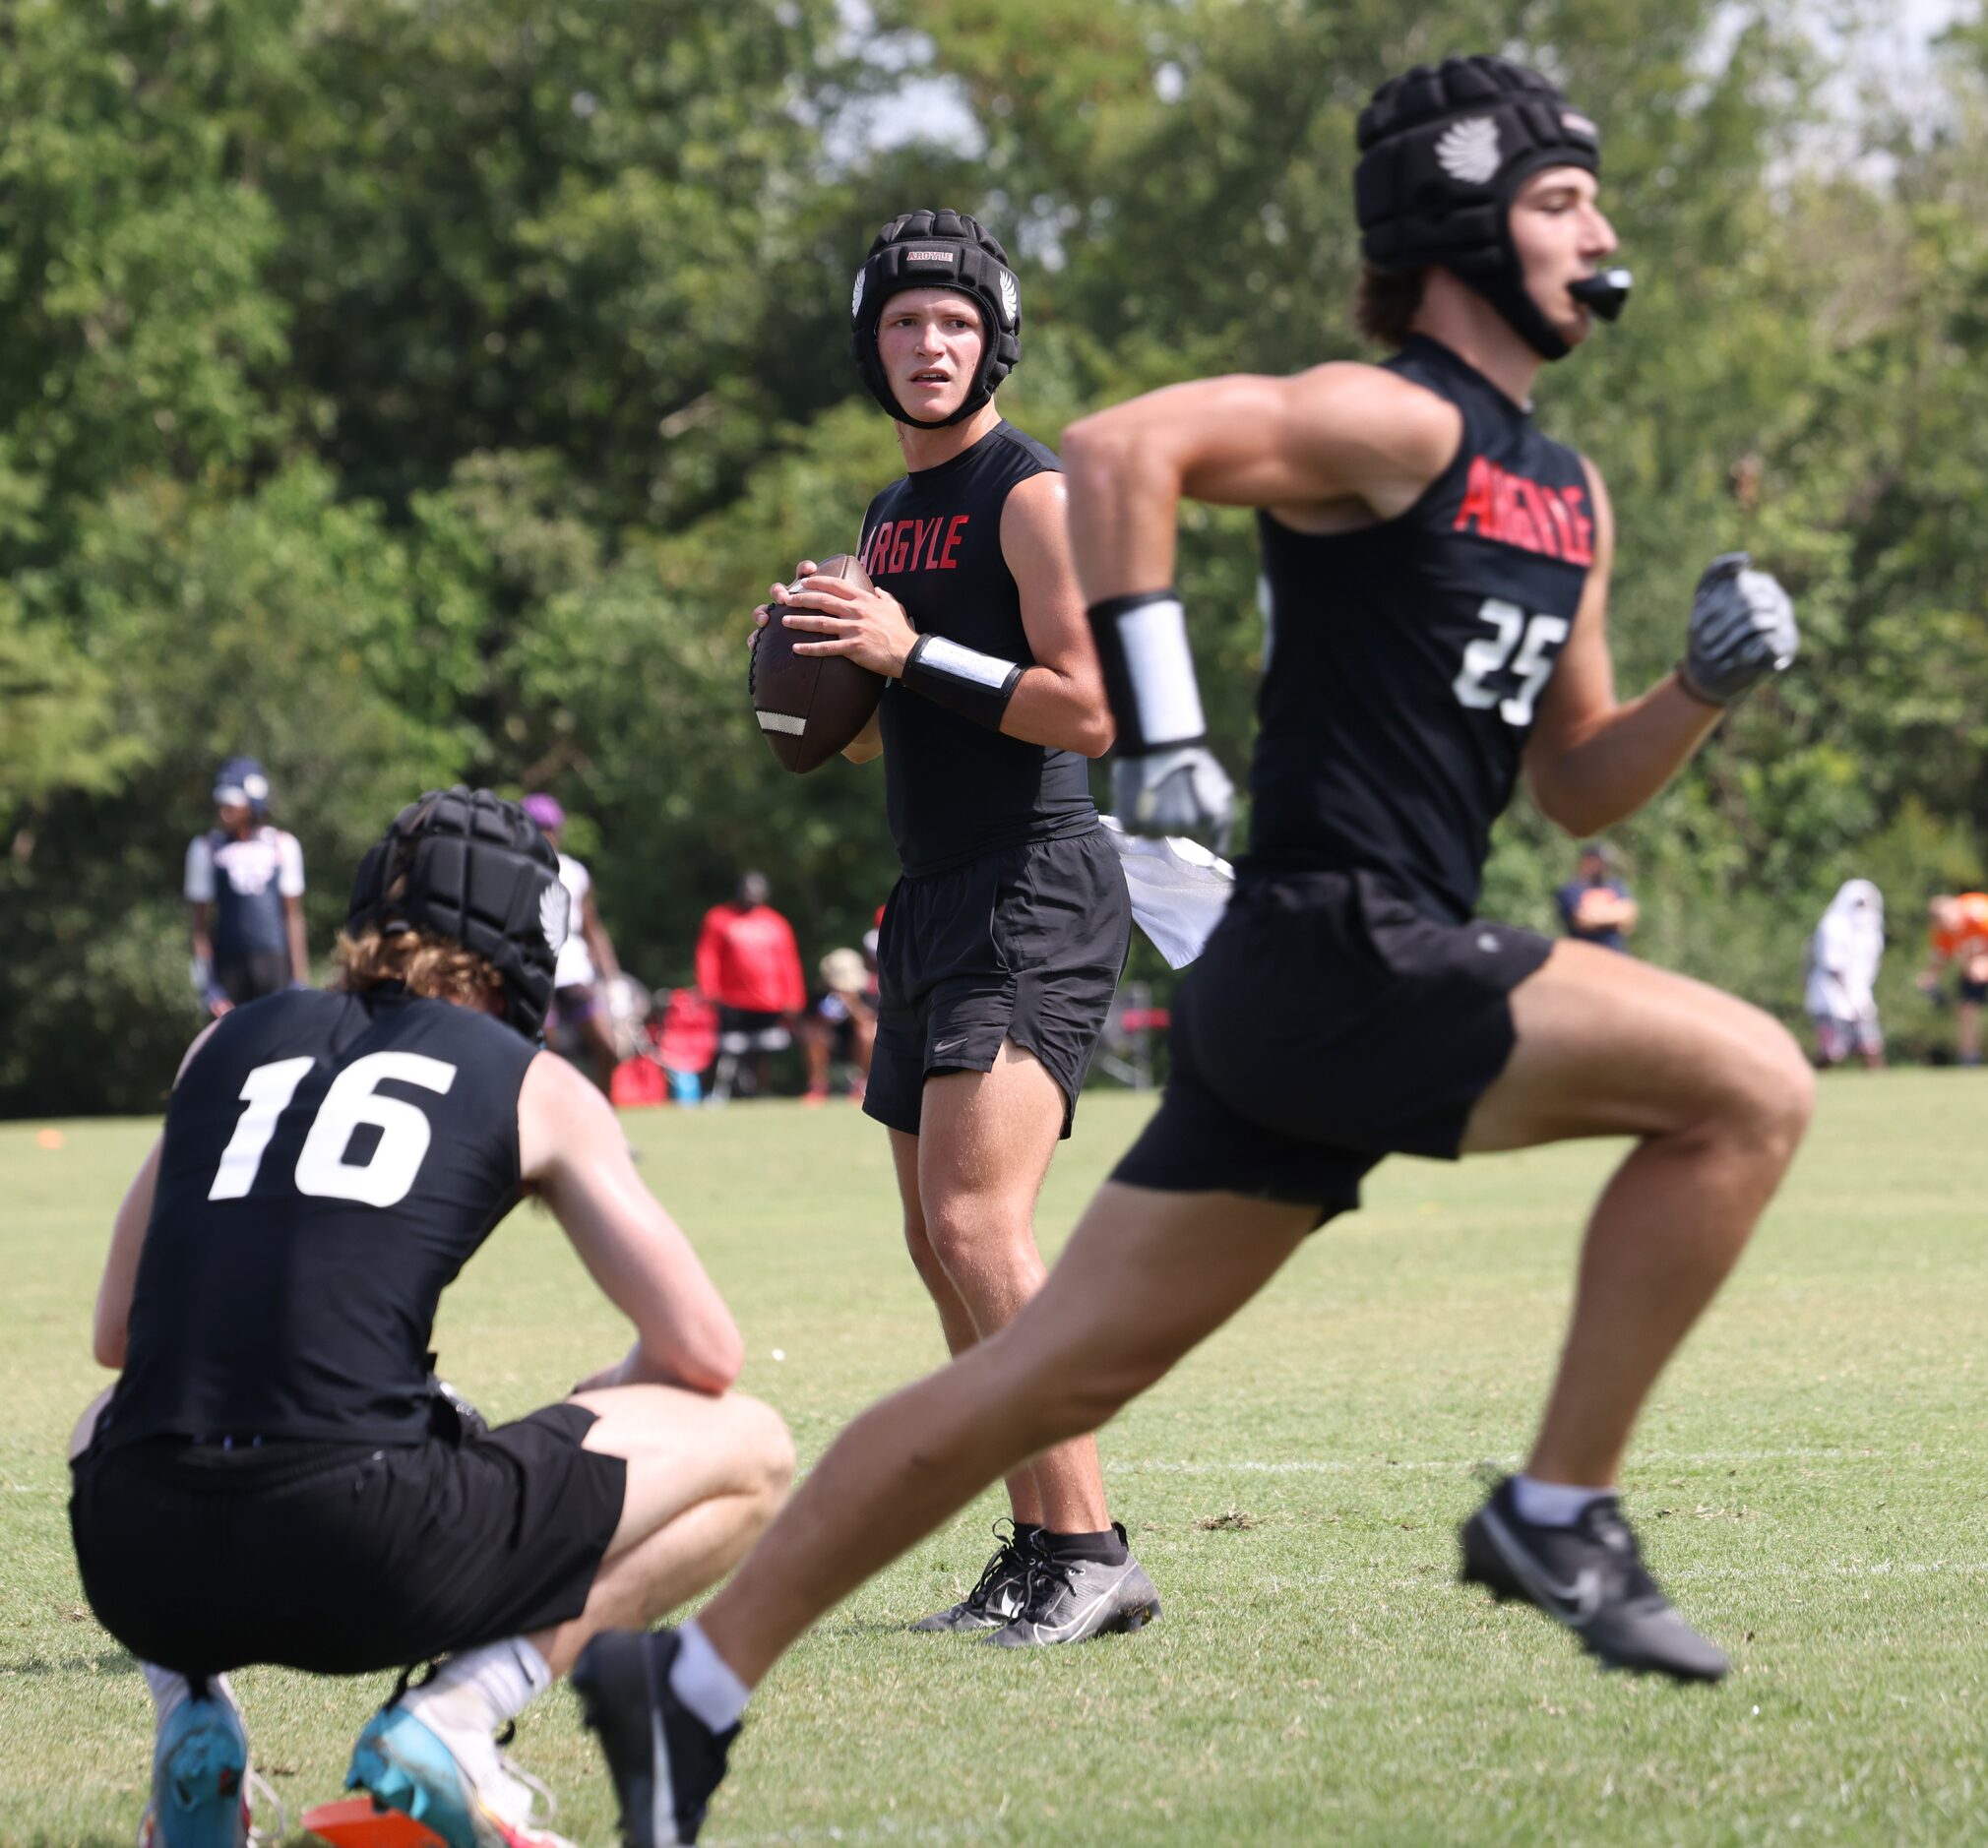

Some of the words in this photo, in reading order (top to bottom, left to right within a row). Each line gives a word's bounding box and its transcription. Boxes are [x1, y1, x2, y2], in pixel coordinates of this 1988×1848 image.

[860, 515, 968, 576] ARGYLE
[1452, 597, 1570, 727] 25
[208, 1051, 458, 1208] 16
